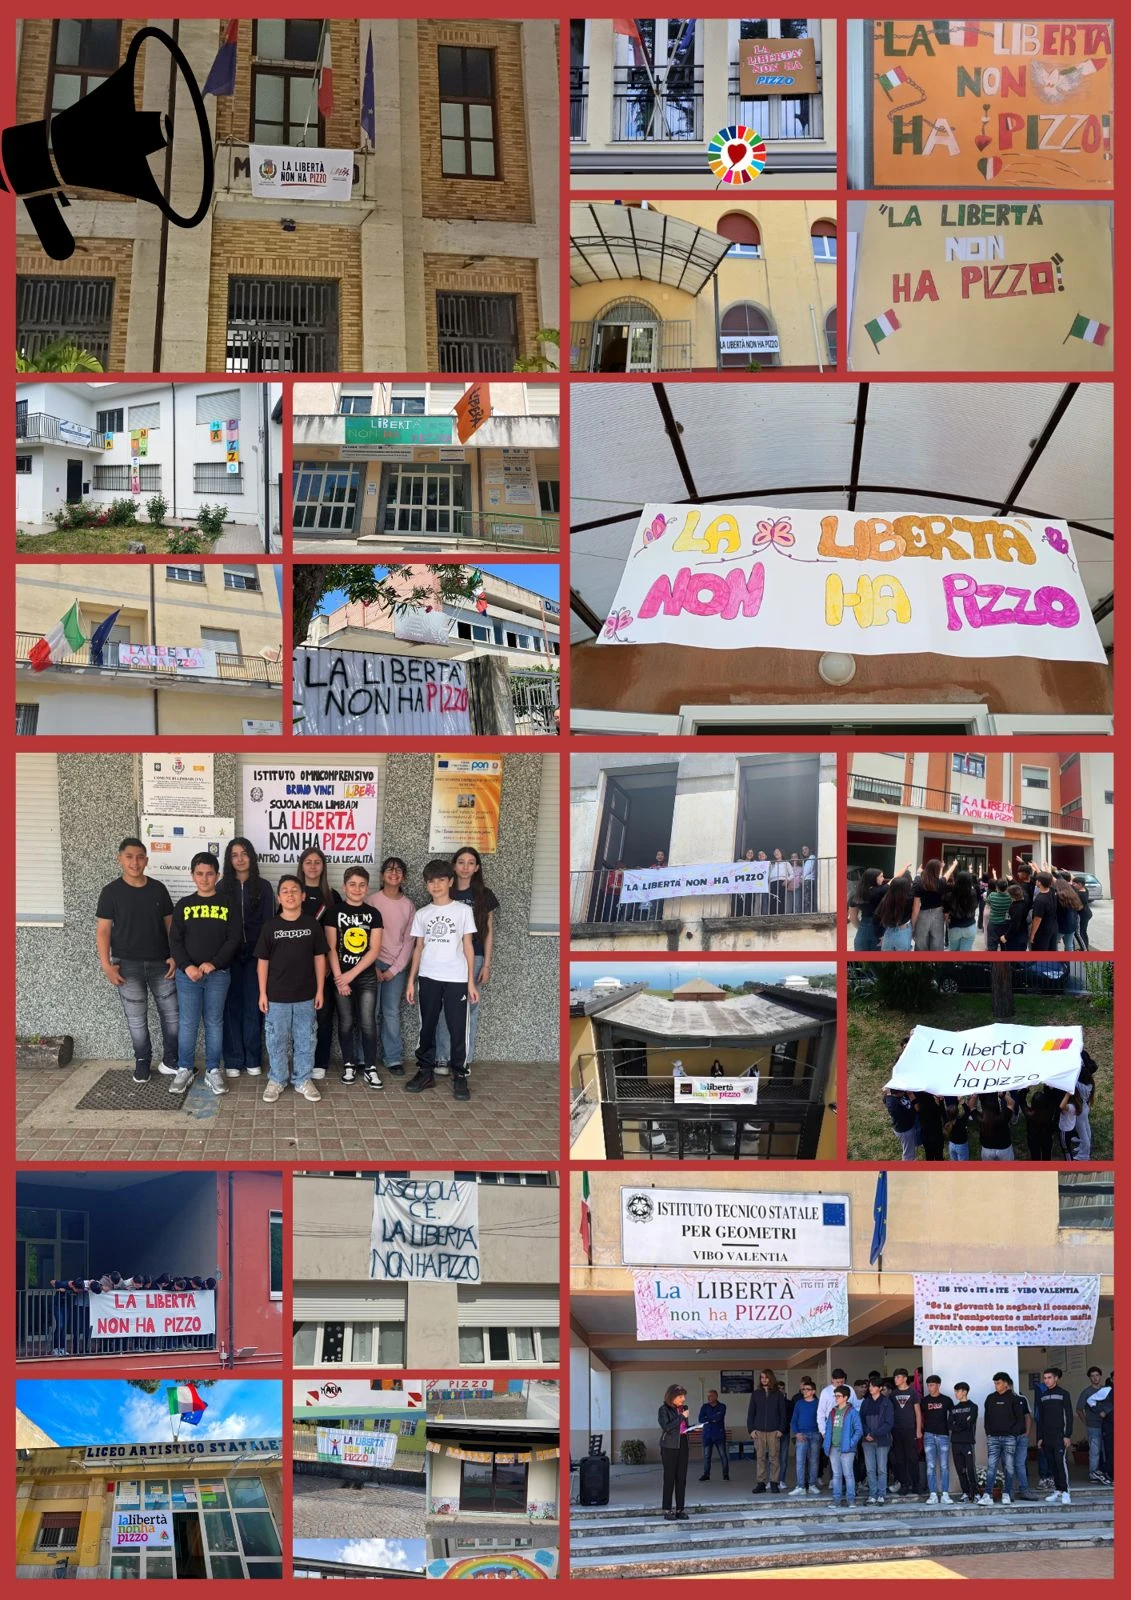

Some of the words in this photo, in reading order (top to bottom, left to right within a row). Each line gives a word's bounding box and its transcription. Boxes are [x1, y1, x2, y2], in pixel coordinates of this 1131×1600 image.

[753, 45, 769, 54] LA
[752, 63, 780, 73] NON
[783, 60, 803, 70] HA
[756, 75, 795, 85] PIZZO
[957, 65, 1027, 97] NON
[892, 114, 961, 156] HA
[282, 161, 291, 171] LA
[295, 161, 324, 172] LIBERTÀ
[281, 172, 294, 182] NON
[298, 173, 306, 182] HA
[310, 173, 326, 183] PIZZO
[945, 235, 1005, 262] NON
[892, 269, 939, 303] HA
[720, 341, 726, 349] LA
[745, 340, 757, 348] NON
[672, 510, 741, 554] LA
[637, 561, 766, 620] NON
[824, 572, 912, 629] HA
[941, 572, 1080, 632] PIZZO
[130, 643, 145, 655] LA
[305, 656, 349, 688] LA
[325, 687, 391, 716] NON
[398, 687, 424, 713] HA
[426, 682, 469, 713] PIZZO
[471, 761, 489, 771] pon
[253, 770, 296, 781] ISTITUTO
[286, 784, 311, 795] BRUNO
[313, 784, 334, 796] VINCI
[270, 800, 301, 809] SCUOLA
[302, 800, 323, 809] MEDIA
[325, 800, 359, 809] LIMBADI
[962, 795, 978, 807] LA
[292, 809, 355, 830] LIBERTÀ
[269, 832, 300, 850] NON
[302, 832, 320, 850] HA
[283, 853, 295, 863] LA
[685, 878, 707, 887] NON
[713, 876, 729, 885] HA
[183, 905, 228, 921] PYREX
[274, 929, 311, 939] Kappa
[928, 1039, 954, 1055] La
[964, 1058, 1012, 1072] NON
[953, 1073, 980, 1088] ha
[983, 1073, 1040, 1090] pizzo
[657, 1202, 713, 1218] ISTITUTO
[715, 1204, 767, 1219] TECNICO
[768, 1205, 819, 1220] STATALE
[382, 1218, 406, 1243] LA
[681, 1224, 711, 1238] PER
[716, 1225, 797, 1240] GEOMETRI
[693, 1250, 724, 1261] VIBO
[727, 1251, 788, 1262] VALENTIA
[371, 1248, 414, 1278] NON
[416, 1252, 438, 1278] HA
[438, 1253, 480, 1281] PIZZO
[655, 1280, 681, 1299] La
[697, 1278, 795, 1300] LIBERTÀ
[114, 1293, 137, 1309] LA
[1006, 1303, 1042, 1311] negherà
[670, 1309, 700, 1321] non
[709, 1307, 727, 1321] ha
[735, 1304, 792, 1321] PIZZO
[97, 1317, 130, 1334] NON
[135, 1317, 155, 1333] HA
[164, 1317, 202, 1333] PIZZO
[449, 1380, 488, 1389] PIZZO
[343, 1435, 353, 1445] LA
[87, 1446, 125, 1458] LICEO
[129, 1443, 204, 1457] ARTISTICO
[210, 1440, 277, 1453] STATALE
[343, 1453, 369, 1462] PIZZO
[117, 1533, 149, 1544] pizzo
